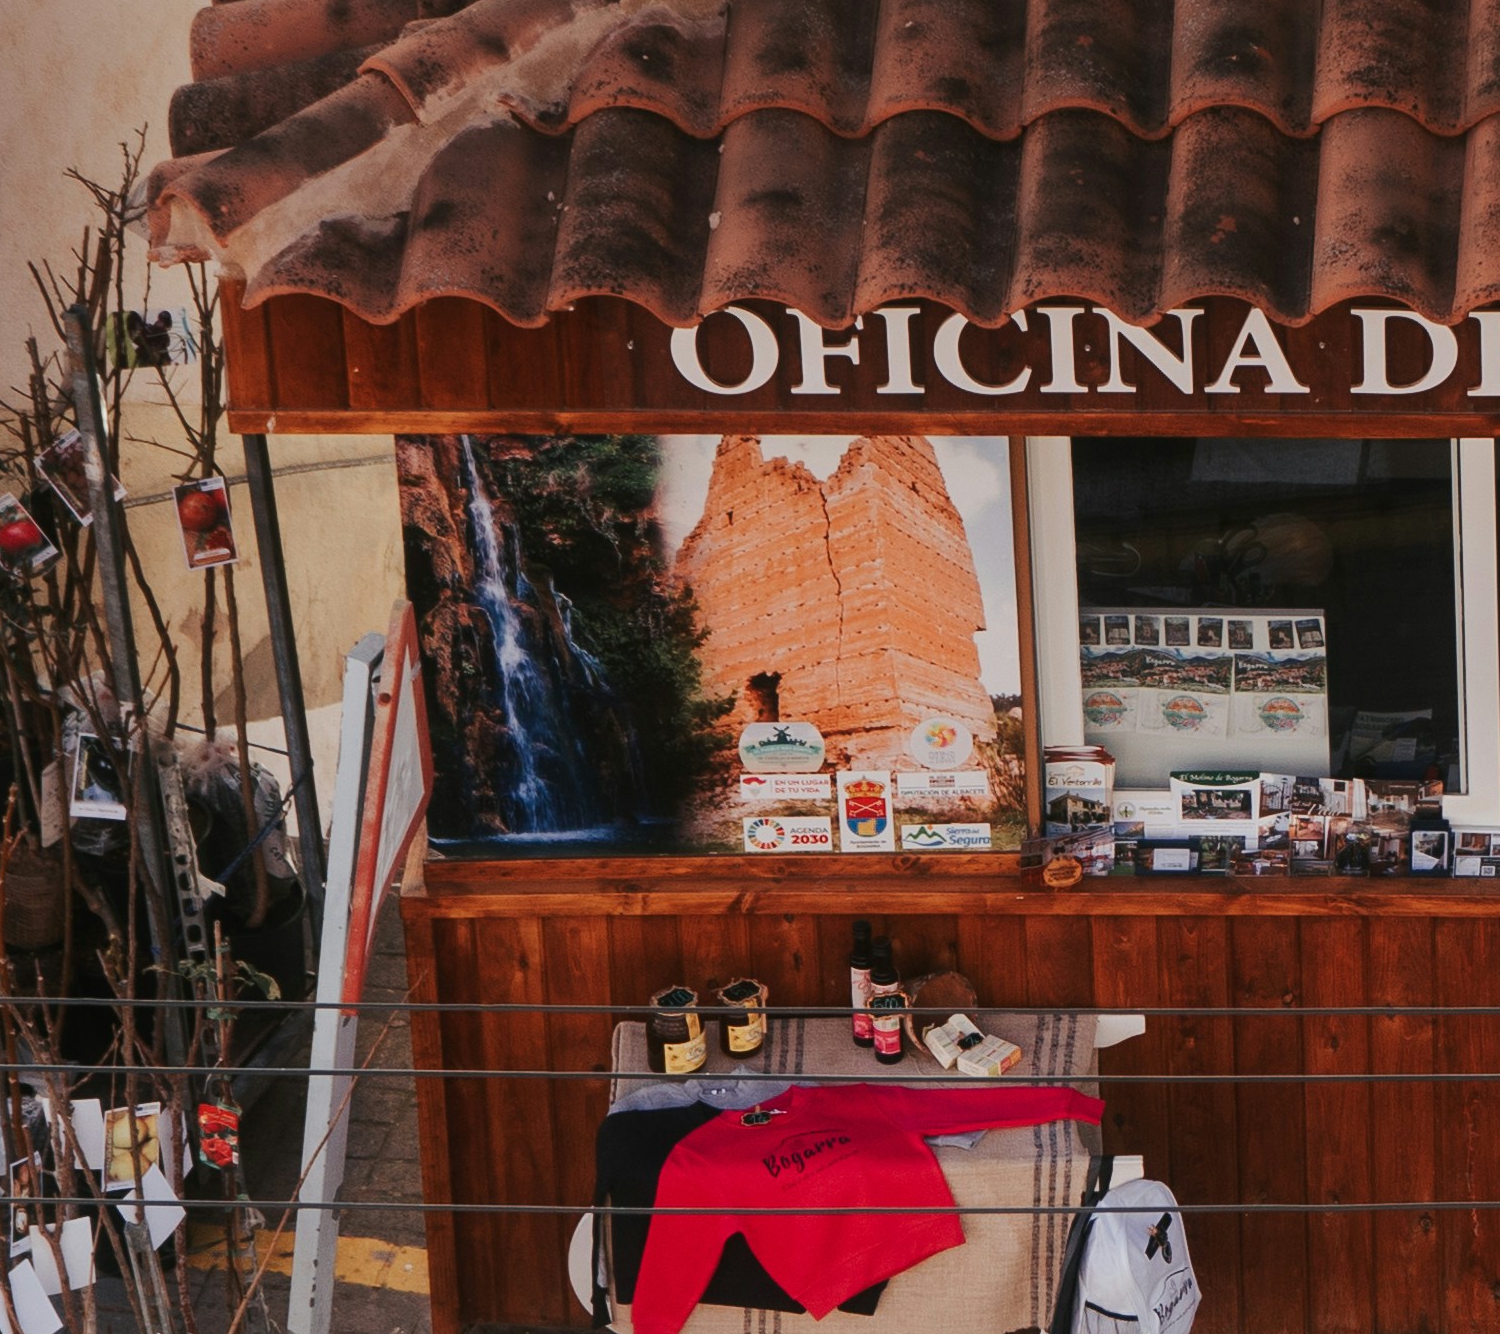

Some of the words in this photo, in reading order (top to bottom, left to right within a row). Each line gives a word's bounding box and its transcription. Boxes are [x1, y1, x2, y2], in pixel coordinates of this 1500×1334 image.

[668, 307, 1312, 396] OFICINA
[1048, 776, 1059, 786] El
[791, 834, 829, 844] 2030
[949, 835, 991, 847] Segura
[762, 1134, 851, 1178] Bogarra
